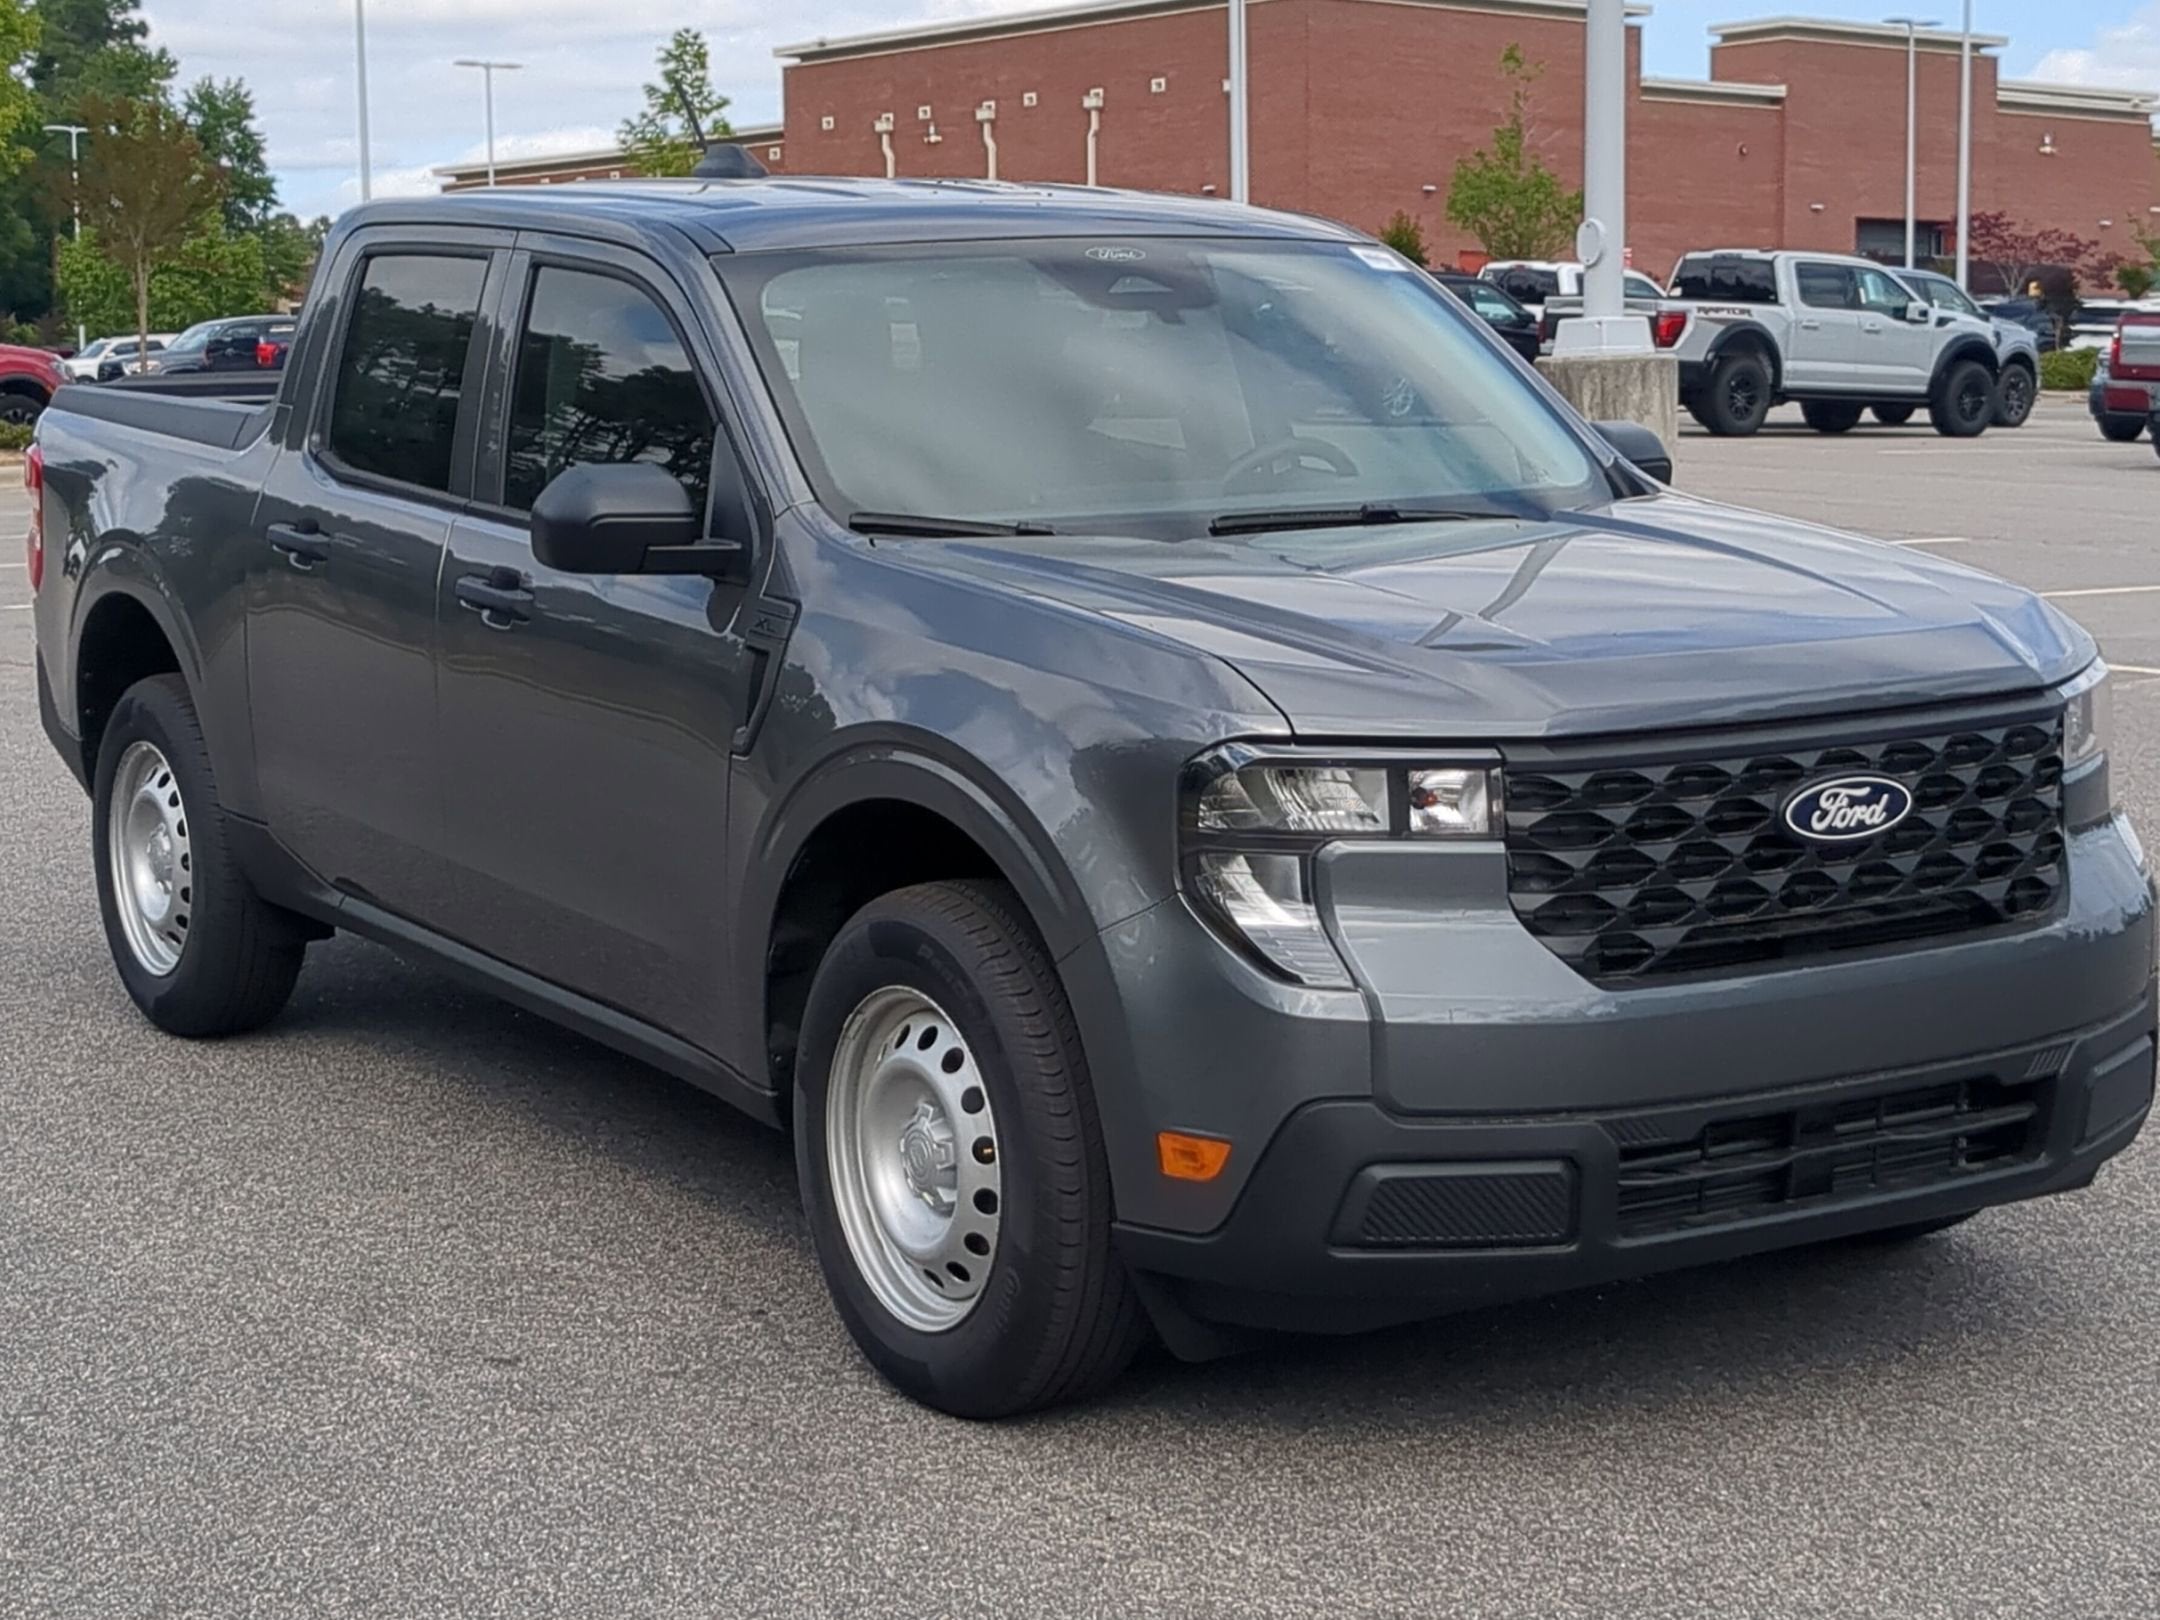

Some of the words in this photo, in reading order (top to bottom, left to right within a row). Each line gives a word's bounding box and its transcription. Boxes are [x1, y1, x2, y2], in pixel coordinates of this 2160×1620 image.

[1696, 305, 1753, 317] RAPTOR
[754, 615, 777, 633] XL
[1810, 786, 1889, 831] Ford
